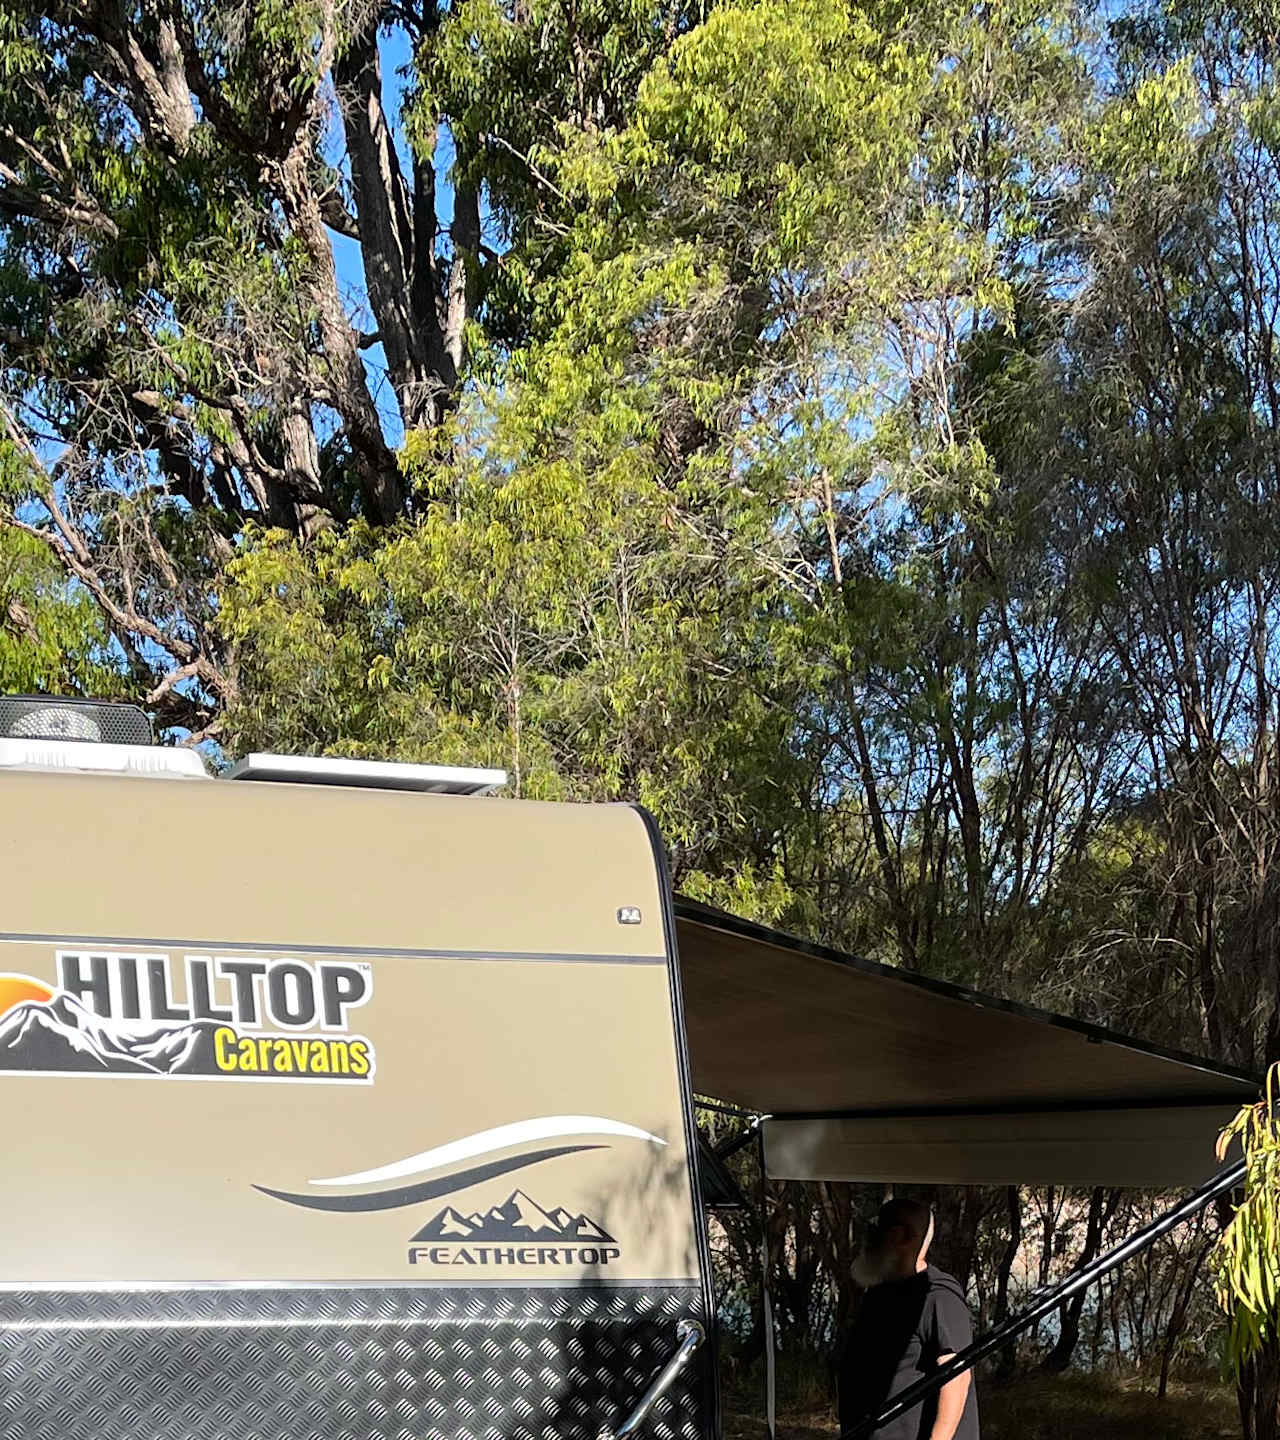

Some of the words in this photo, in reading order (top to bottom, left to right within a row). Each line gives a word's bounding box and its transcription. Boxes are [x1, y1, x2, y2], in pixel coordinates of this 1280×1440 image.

[62, 956, 365, 1026] HILLTOP
[215, 1027, 370, 1075] Caravans
[409, 1247, 620, 1265] FEATHERTOP
